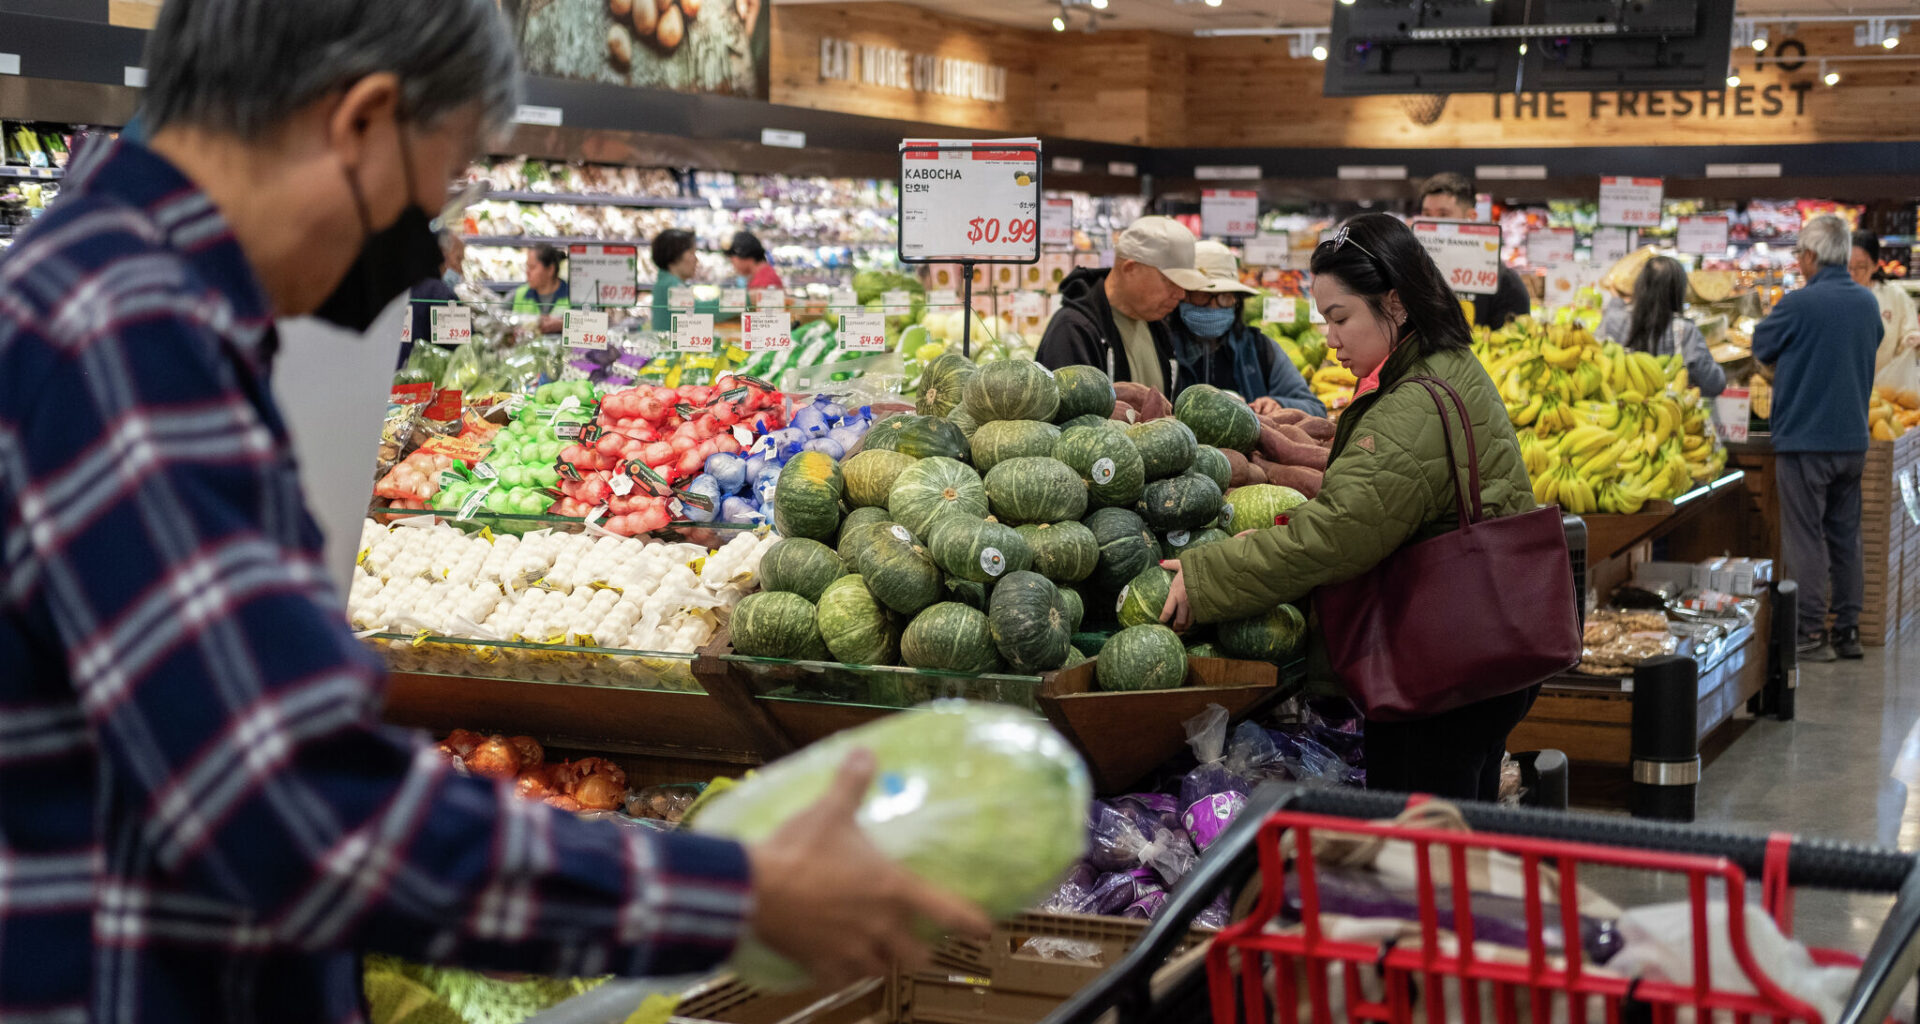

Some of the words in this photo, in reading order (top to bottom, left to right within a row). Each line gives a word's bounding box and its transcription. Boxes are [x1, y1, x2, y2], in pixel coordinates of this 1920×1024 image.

[821, 38, 857, 80] EAT
[1590, 83, 1812, 118] FRESHEST
[905, 168, 962, 179] KABOCHA
[905, 184, 930, 193] 단호박
[967, 216, 1037, 245] $0.99
[1447, 239, 1480, 247] BANANA
[1451, 267, 1498, 287] $0.49
[600, 285, 637, 300] $0.79
[583, 333, 606, 344] $1.99
[765, 336, 791, 347] $1.99
[860, 335, 884, 346] $4.99
